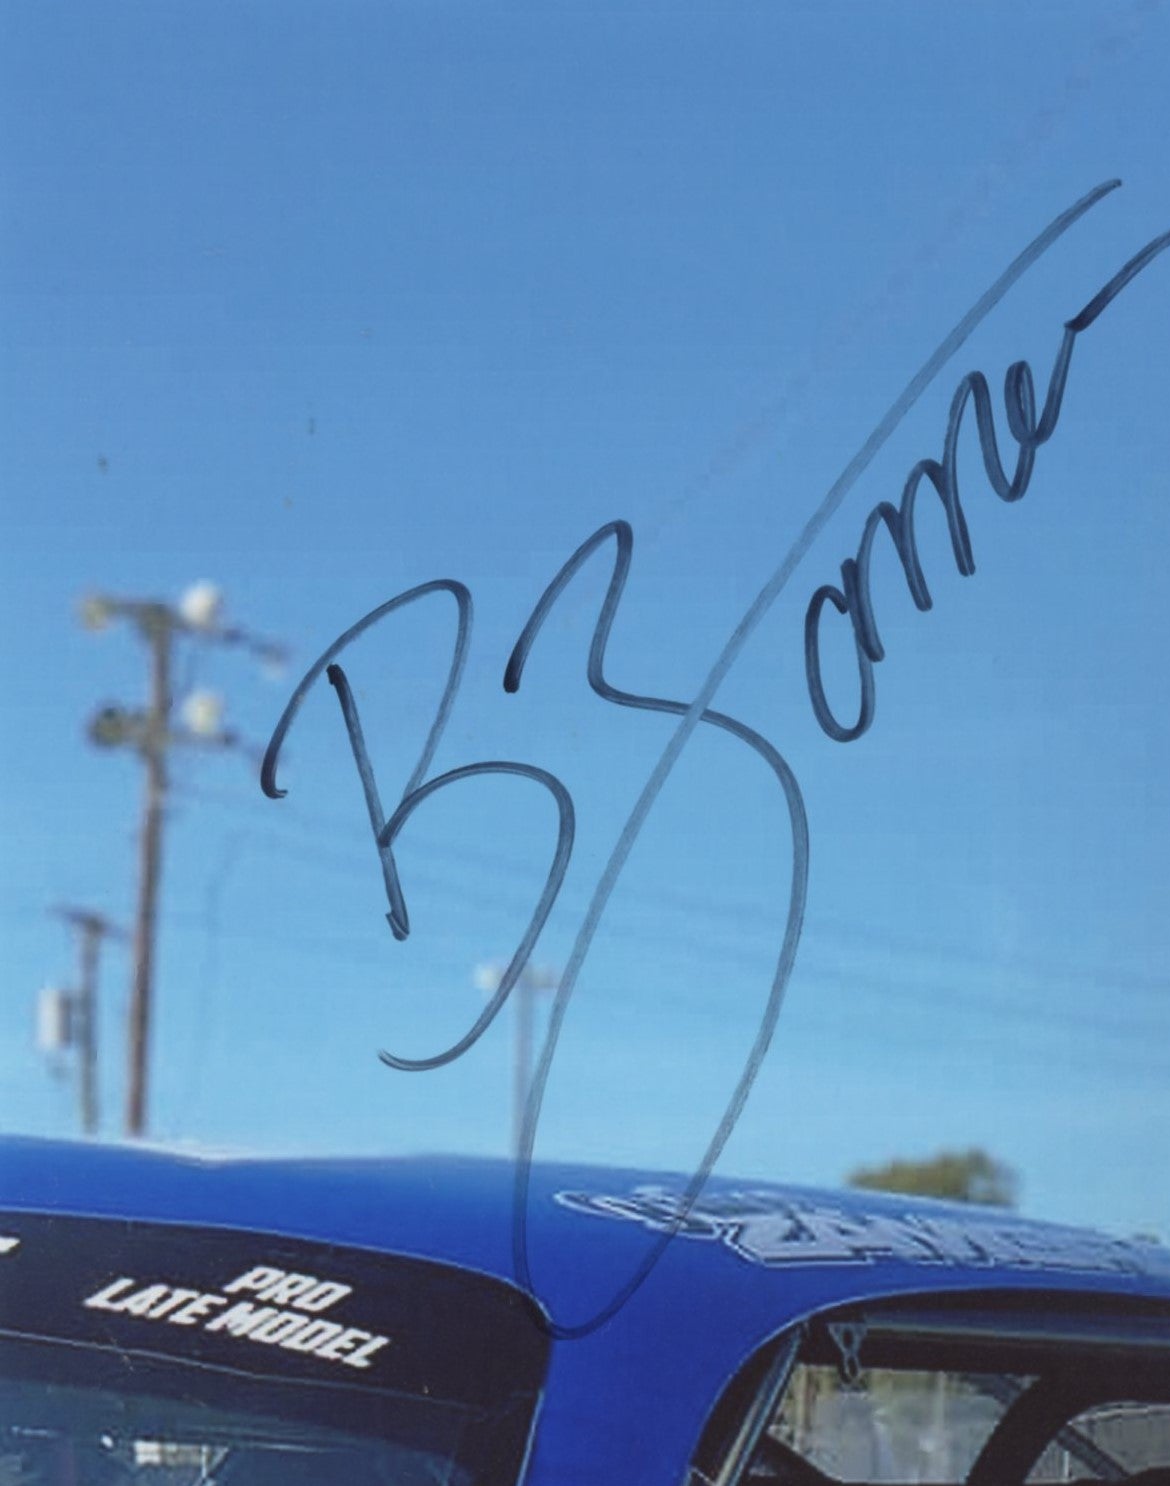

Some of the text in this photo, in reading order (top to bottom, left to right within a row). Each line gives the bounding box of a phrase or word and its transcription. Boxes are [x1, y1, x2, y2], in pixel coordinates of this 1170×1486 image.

[83, 1277, 390, 1368] LATE MODEL
[222, 1265, 352, 1312] PRO
